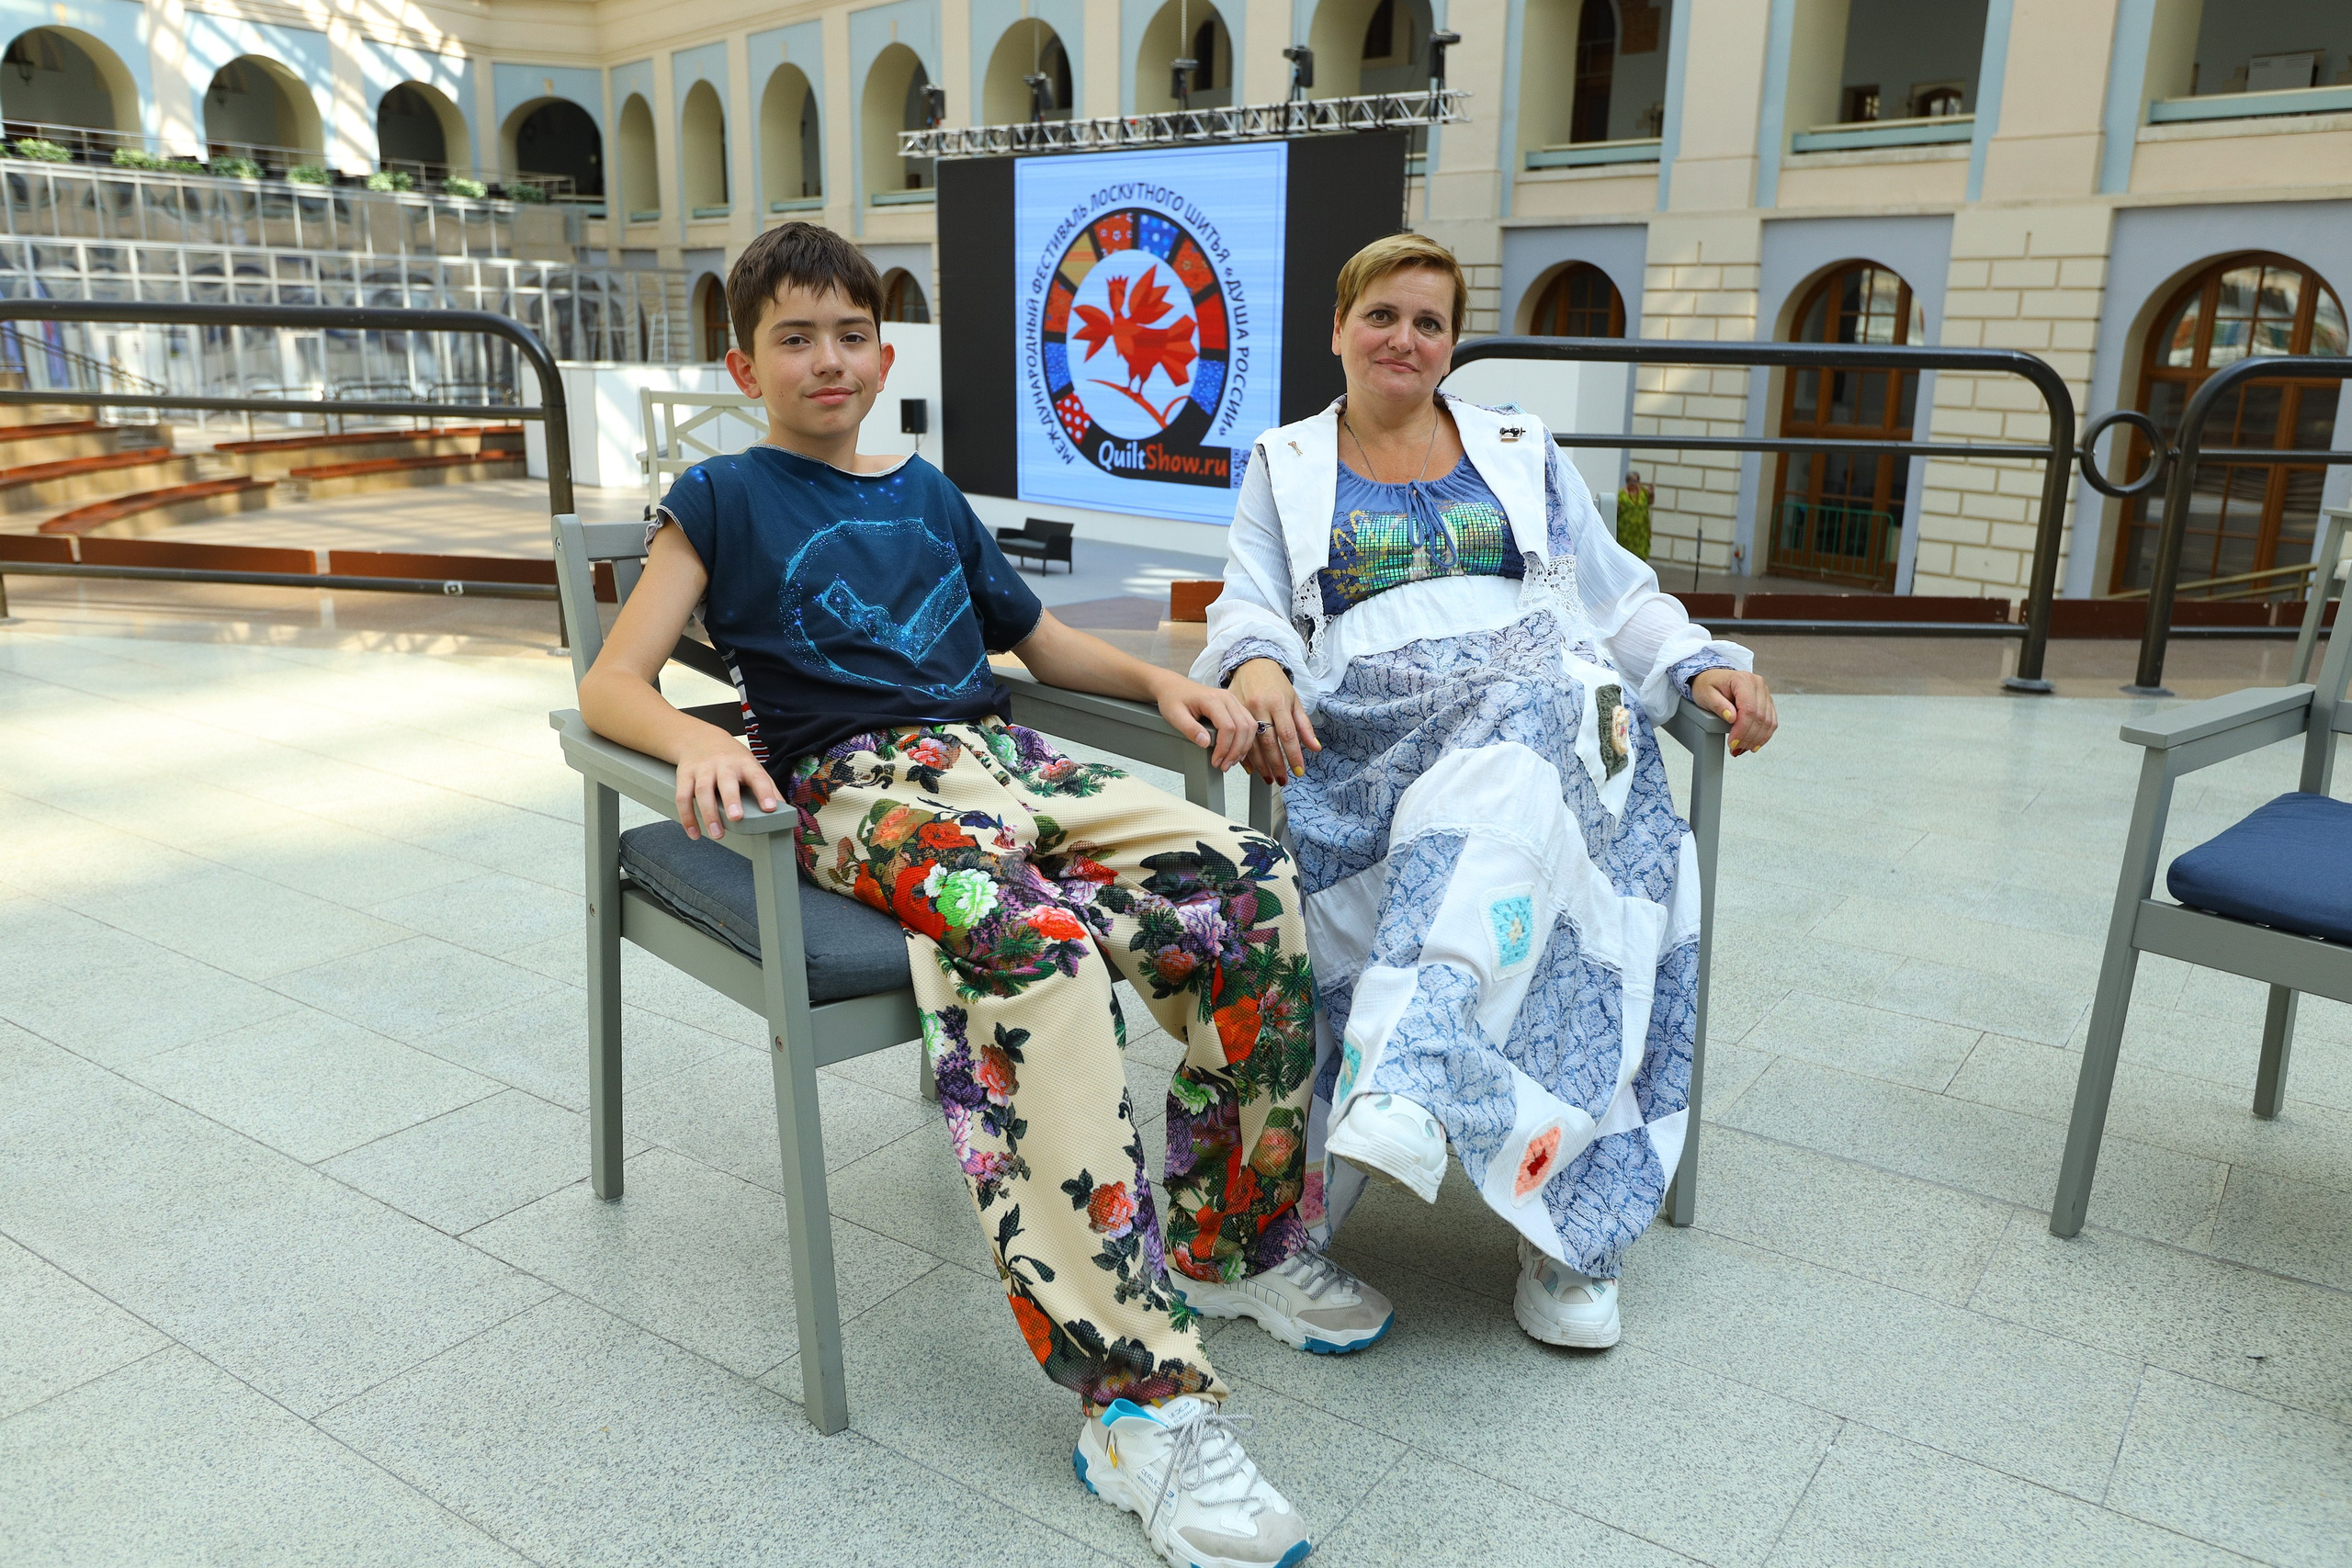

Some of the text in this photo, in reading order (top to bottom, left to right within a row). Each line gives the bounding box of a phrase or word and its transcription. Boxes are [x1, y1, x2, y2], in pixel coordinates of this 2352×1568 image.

[1090, 182, 1184, 212] ЛОСКУТНОГО
[1032, 204, 1088, 294] ФЕСТИВАЛЬ
[1183, 203, 1230, 264] ШИТЬЯ
[1025, 297, 1075, 465] МЕЖДУНАРОДНЫЙ
[1098, 440, 1228, 477] QuiltShow.ru
